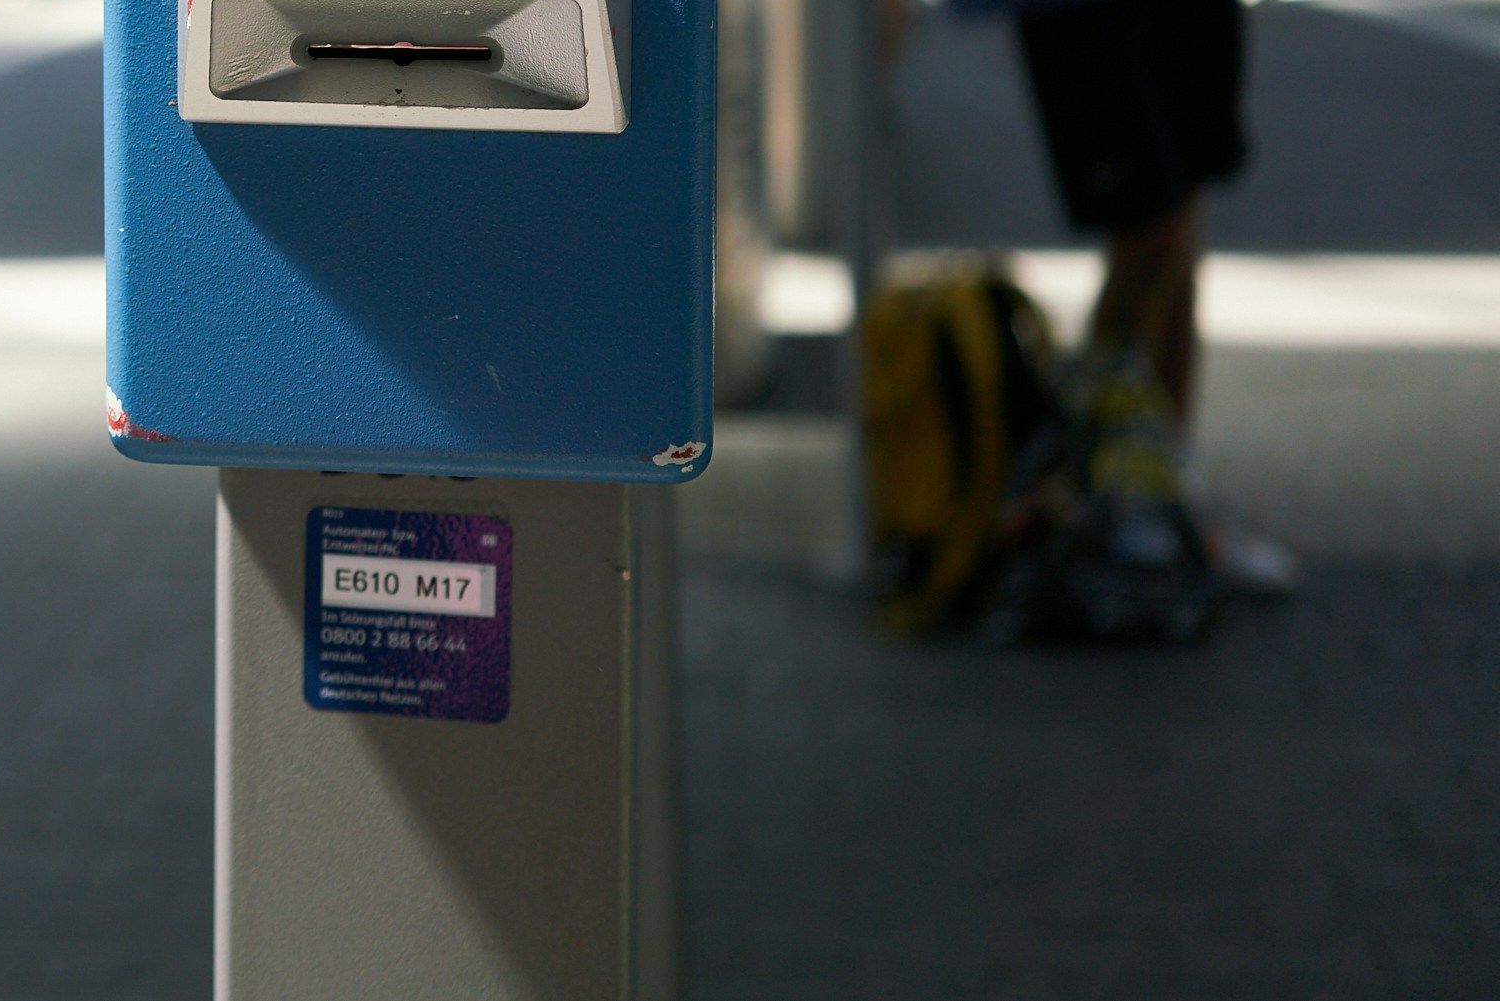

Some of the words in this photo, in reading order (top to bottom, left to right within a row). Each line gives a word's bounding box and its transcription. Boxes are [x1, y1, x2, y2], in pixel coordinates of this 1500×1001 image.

[335, 568, 399, 595] E610
[417, 575, 471, 600] M17
[321, 610, 338, 623] Im
[320, 626, 367, 646] 0800
[371, 629, 383, 647] 2
[387, 631, 411, 650] 88
[415, 633, 439, 652] 66
[443, 636, 468, 653] 44
